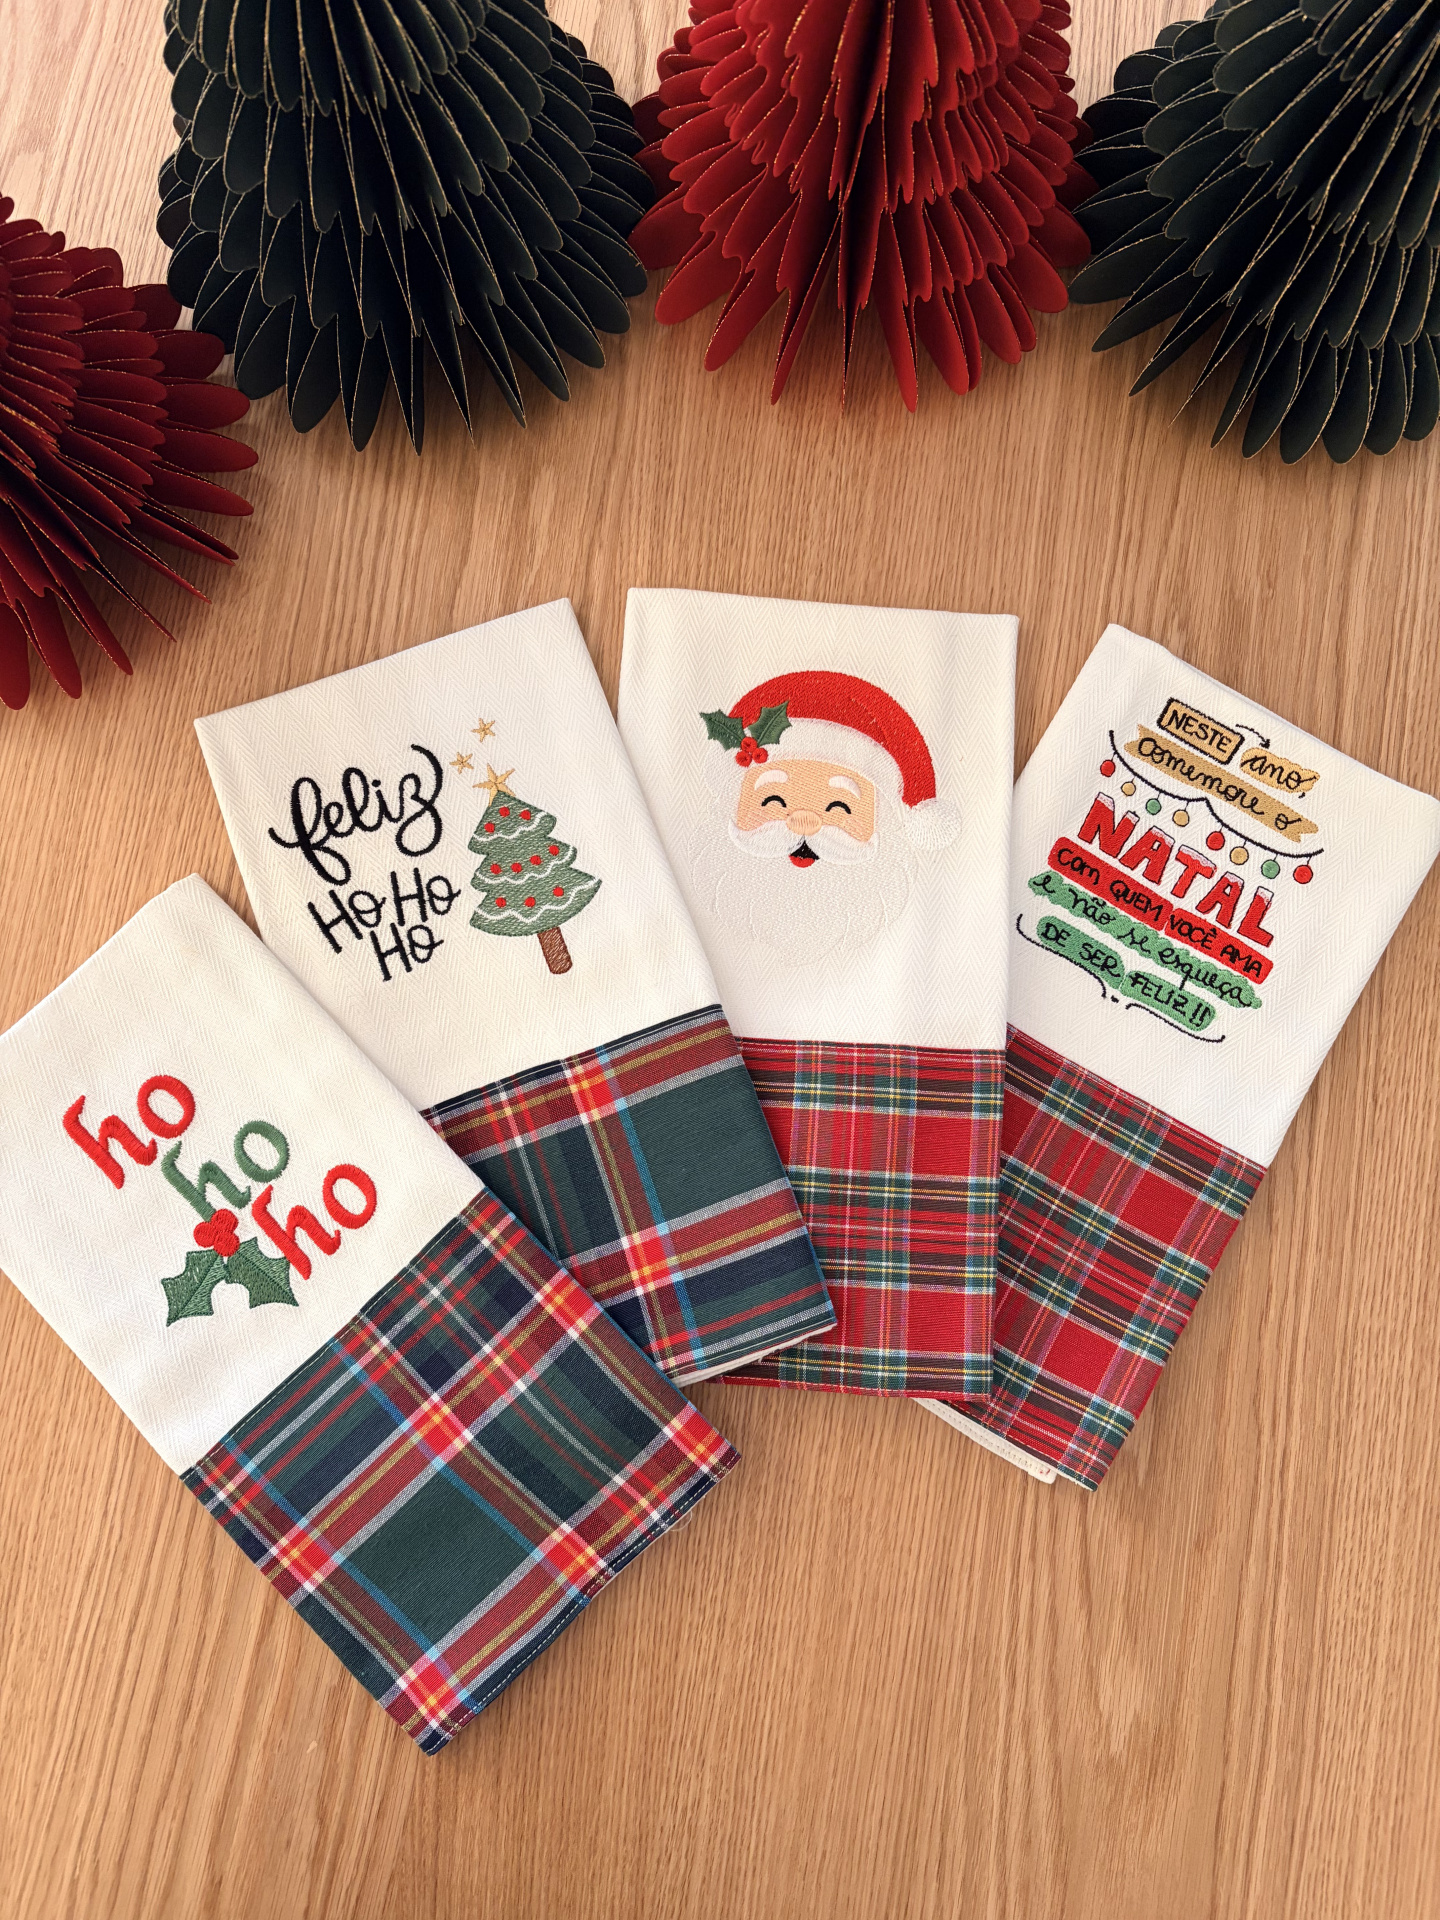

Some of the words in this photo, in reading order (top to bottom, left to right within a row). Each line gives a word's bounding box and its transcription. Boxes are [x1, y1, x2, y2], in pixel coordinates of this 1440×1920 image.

[1167, 709, 1232, 753] NESTE
[268, 743, 444, 886] feliz
[1274, 813, 1302, 831] o
[1077, 791, 1274, 948] NATAL
[1032, 874, 1056, 894] e
[1068, 888, 1116, 925] não
[1117, 927, 1151, 955] se
[1157, 946, 1252, 1007] esqueça
[1040, 922, 1072, 948] DE
[1078, 942, 1121, 978] SER
[1109, 879, 1164, 922] QUEM
[1169, 914, 1218, 951] VOCÊ
[1219, 943, 1262, 978] AMA
[62, 1074, 196, 1190] ho
[160, 1120, 290, 1222] ho
[251, 1163, 377, 1281] ho
